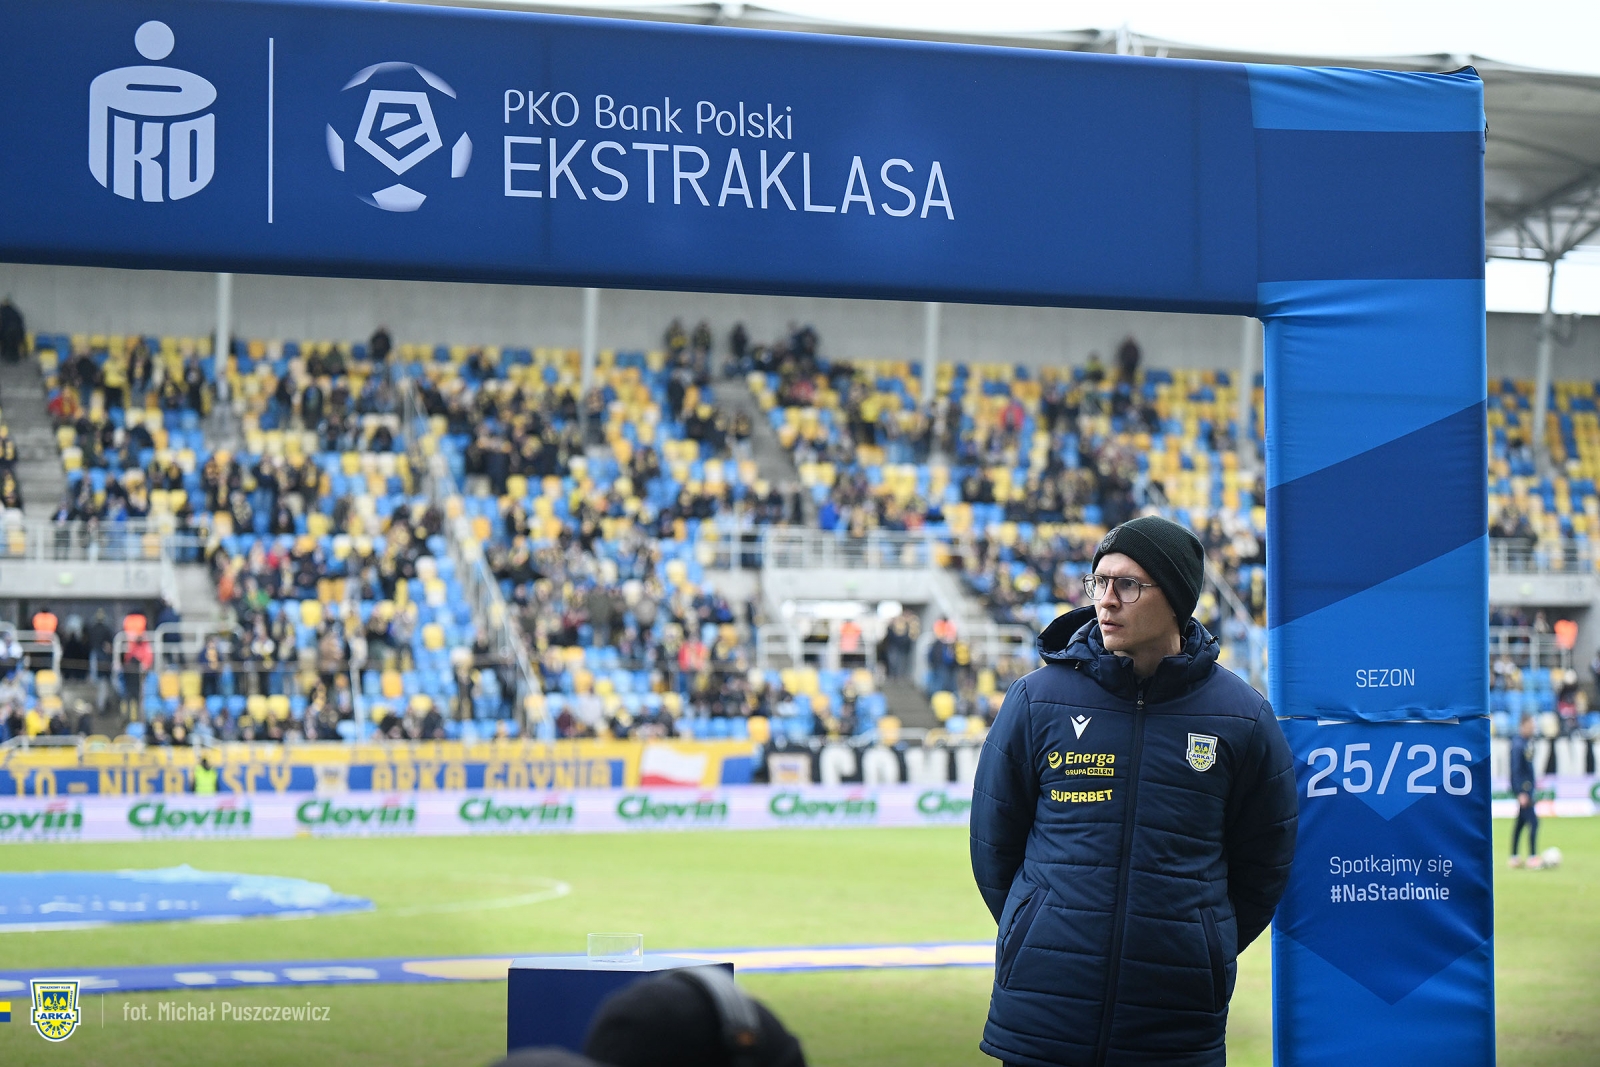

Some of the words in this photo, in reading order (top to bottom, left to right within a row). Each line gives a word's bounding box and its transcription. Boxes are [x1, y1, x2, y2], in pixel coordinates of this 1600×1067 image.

[504, 89, 580, 127] PKO
[595, 94, 683, 134] Bank
[696, 100, 792, 140] Polski
[504, 135, 955, 220] EKSTRAKLASA
[1356, 668, 1415, 688] SEZON
[1065, 751, 1116, 767] Energa
[1307, 741, 1473, 798] 25/26
[1065, 768, 1087, 776] GRUPA
[1088, 768, 1113, 776] ORLEN
[1051, 789, 1113, 803] SUPERBET
[0, 801, 83, 830] ovin
[1330, 855, 1422, 877] Spotkajmy
[1427, 855, 1453, 878] się
[1330, 882, 1450, 903] #NaStadionie
